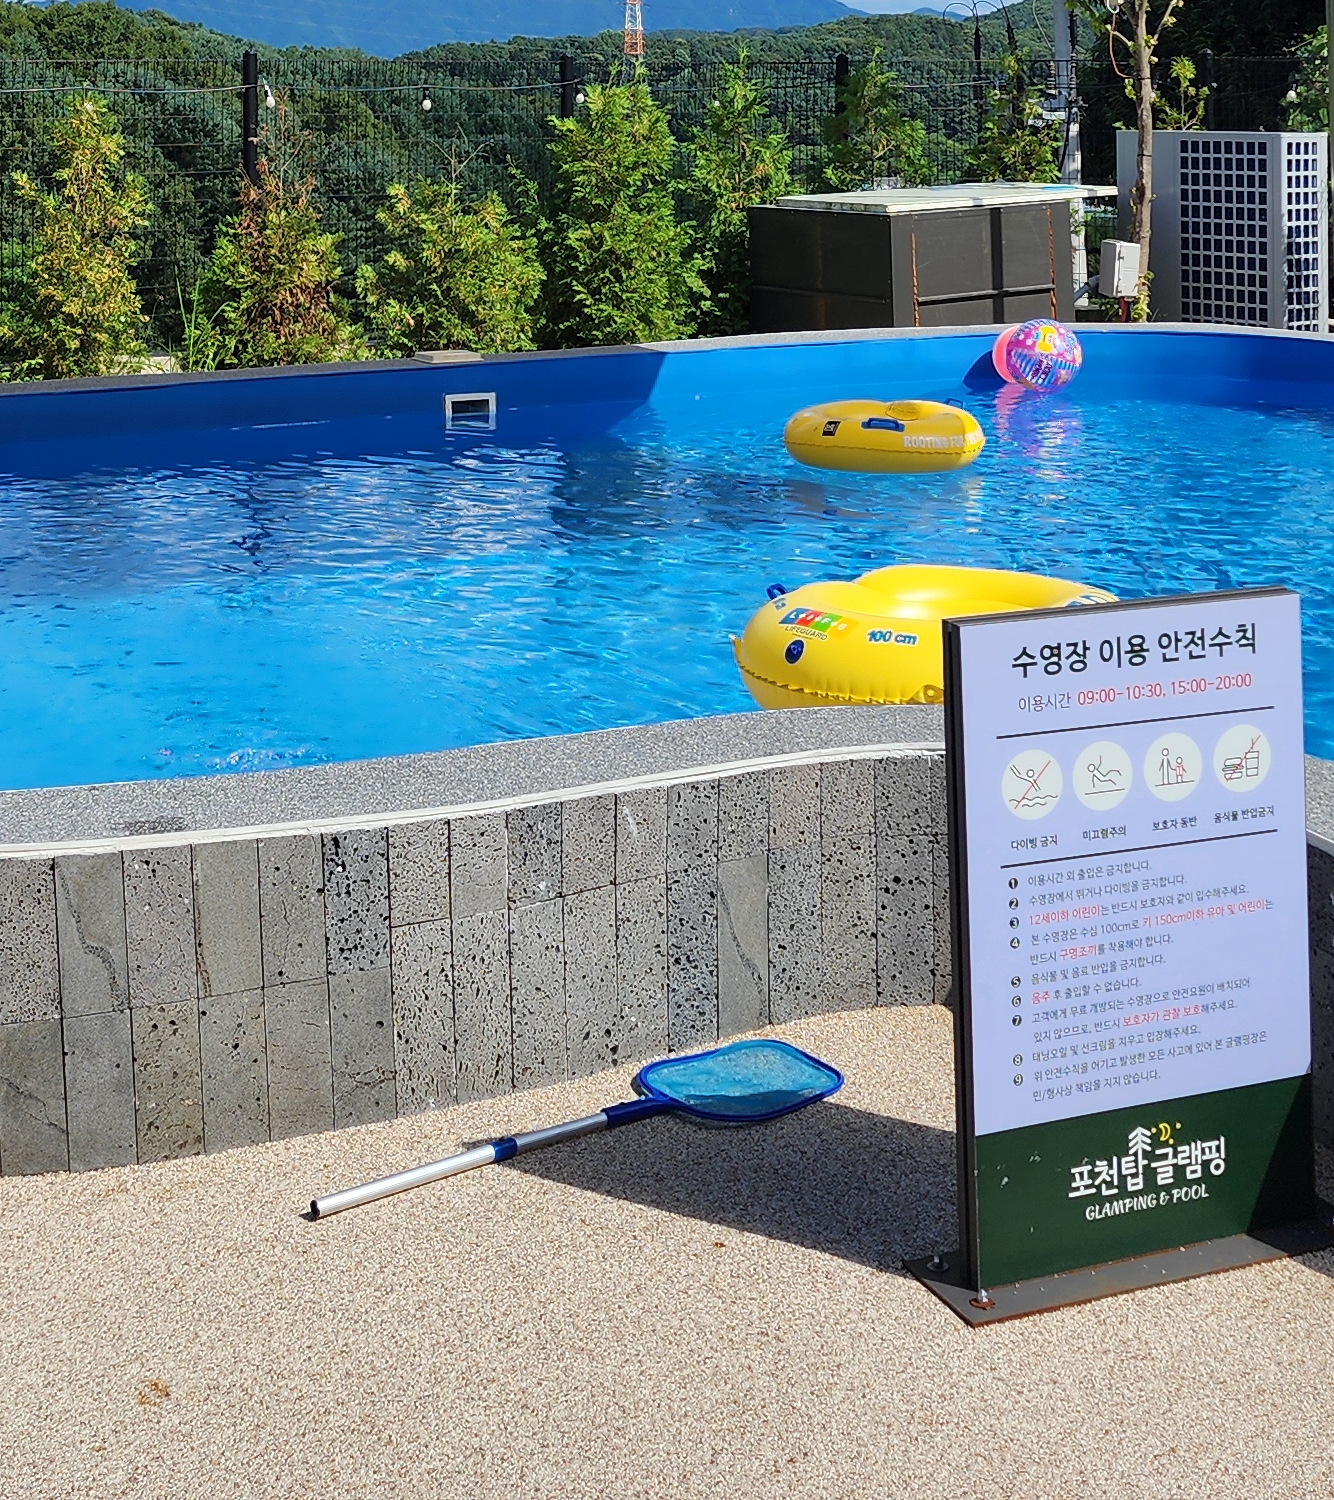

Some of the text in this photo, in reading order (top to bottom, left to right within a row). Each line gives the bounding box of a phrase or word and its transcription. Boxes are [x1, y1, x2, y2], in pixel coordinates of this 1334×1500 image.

[785, 625, 828, 641] LIFEGUARD
[867, 629, 918, 646] 100 cm
[1012, 623, 1257, 678] 수영장 이용 안전수칙
[1019, 692, 1073, 716] 이용시간
[1171, 673, 1252, 695] 15:00-20:00
[1152, 816, 1198, 831] 보호자 동반
[1214, 805, 1275, 823] 음식물 반입금지
[1011, 834, 1058, 851] 다이빙 금지
[1083, 825, 1127, 841] 미끄럼주의
[1028, 872, 1064, 886] 이용시간
[1066, 870, 1076, 881] 외
[1077, 866, 1105, 880] 출입은
[1106, 860, 1153, 876] 금지합니다.
[1029, 890, 1074, 906] 수영장에서
[1105, 881, 1140, 895] 다이빙을
[1141, 874, 1188, 890] 금지합니다.
[1030, 910, 1071, 925] 12세이하
[1072, 905, 1110, 919] 어린이는
[1111, 900, 1138, 914] 반드시
[1140, 895, 1175, 909] 보호자와
[1177, 892, 1194, 904] 같이
[1196, 884, 1250, 901] 입수해주세요.
[1031, 934, 1041, 946] 본
[1042, 928, 1079, 944] 수영장은
[1081, 925, 1098, 938] 수심
[1101, 920, 1141, 934] 100cm로
[1143, 916, 1152, 928] 키
[1155, 909, 1205, 926] 150cm이하
[1207, 906, 1225, 918] 유아
[1227, 904, 1236, 916] 및
[1238, 899, 1274, 913] 어린이는
[1030, 933, 1174, 965] 반드시 구명조끼를 착용해야 합니다.
[1031, 971, 1058, 985] 음식물
[1060, 969, 1069, 980] 및
[1072, 966, 1090, 978] 음료
[1091, 961, 1118, 975] 반입을
[1120, 954, 1166, 970] 금지합니다.
[1032, 991, 1051, 1004] 음주
[1053, 990, 1063, 1000] 후
[1064, 985, 1092, 999] 출입할
[1093, 984, 1102, 994] 수
[1104, 977, 1143, 992] 없습니다.
[1032, 1008, 1068, 1023] 고객에게
[1070, 1005, 1088, 1017] 무료
[1090, 999, 1126, 1013] 개방되는
[1127, 992, 1171, 1008] 수영장으로
[1172, 984, 1215, 1000] 안전요원이
[1217, 978, 1251, 992] 배치되어
[1034, 1030, 1052, 1043] 있지
[1094, 1018, 1121, 1032] 반드시
[1123, 1011, 1160, 1027] 보호자가
[1163, 1008, 1181, 1021] 관찰
[1183, 1000, 1238, 1016] 보호해주세요.
[1033, 1047, 1068, 1062] 태닝오일
[1070, 1044, 1079, 1056] 및
[1081, 1038, 1117, 1054] 선크림을
[1118, 1034, 1145, 1047] 지우고
[1147, 1025, 1202, 1042] 입장해주세요.
[1034, 1070, 1043, 1082] 위
[1045, 1062, 1089, 1080] 안전수칙을
[1091, 1058, 1119, 1071] 어기고
[1120, 1052, 1146, 1066] 발생한
[1148, 1049, 1166, 1061] 모든
[1167, 1044, 1194, 1057] 사고에
[1195, 1040, 1213, 1053] 있어
[1215, 1039, 1224, 1050] 본
[1226, 1031, 1268, 1048] 글램핑장은
[1075, 1079, 1102, 1092] 책임을
[1104, 1076, 1121, 1088] 지지
[1123, 1069, 1161, 1085] 않습니다.
[1086, 1183, 1210, 1220] GLAMPING & POOL
